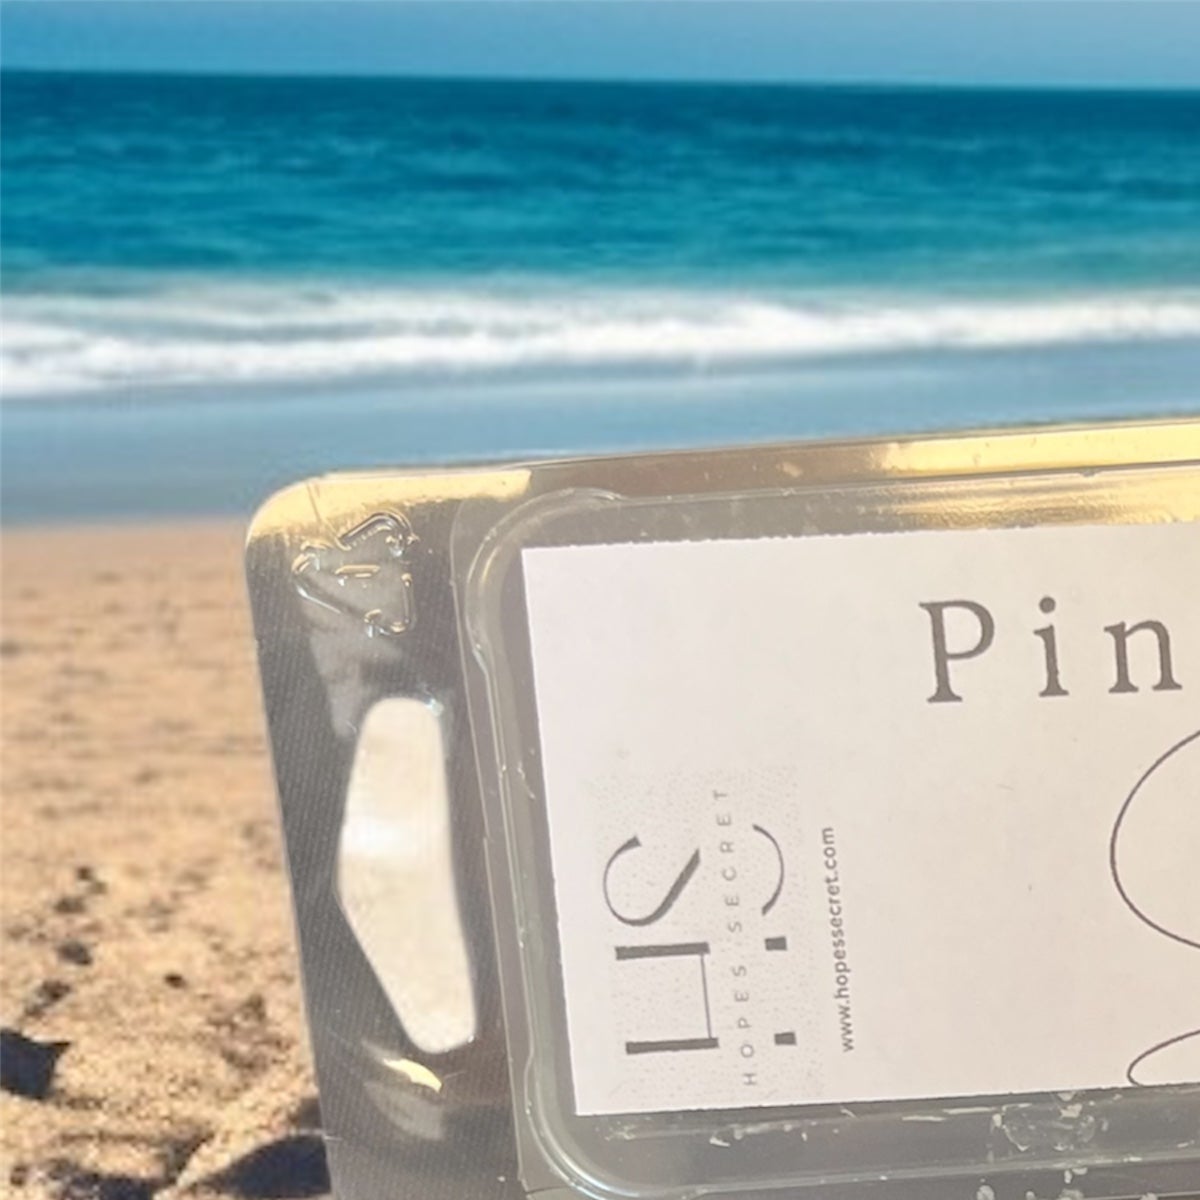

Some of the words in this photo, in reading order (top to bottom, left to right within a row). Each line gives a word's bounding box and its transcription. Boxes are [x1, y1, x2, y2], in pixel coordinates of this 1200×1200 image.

[712, 789, 743, 933] SECRET
[821, 826, 855, 1053] www.hopessecret.com
[731, 963, 758, 1086] HOPES
